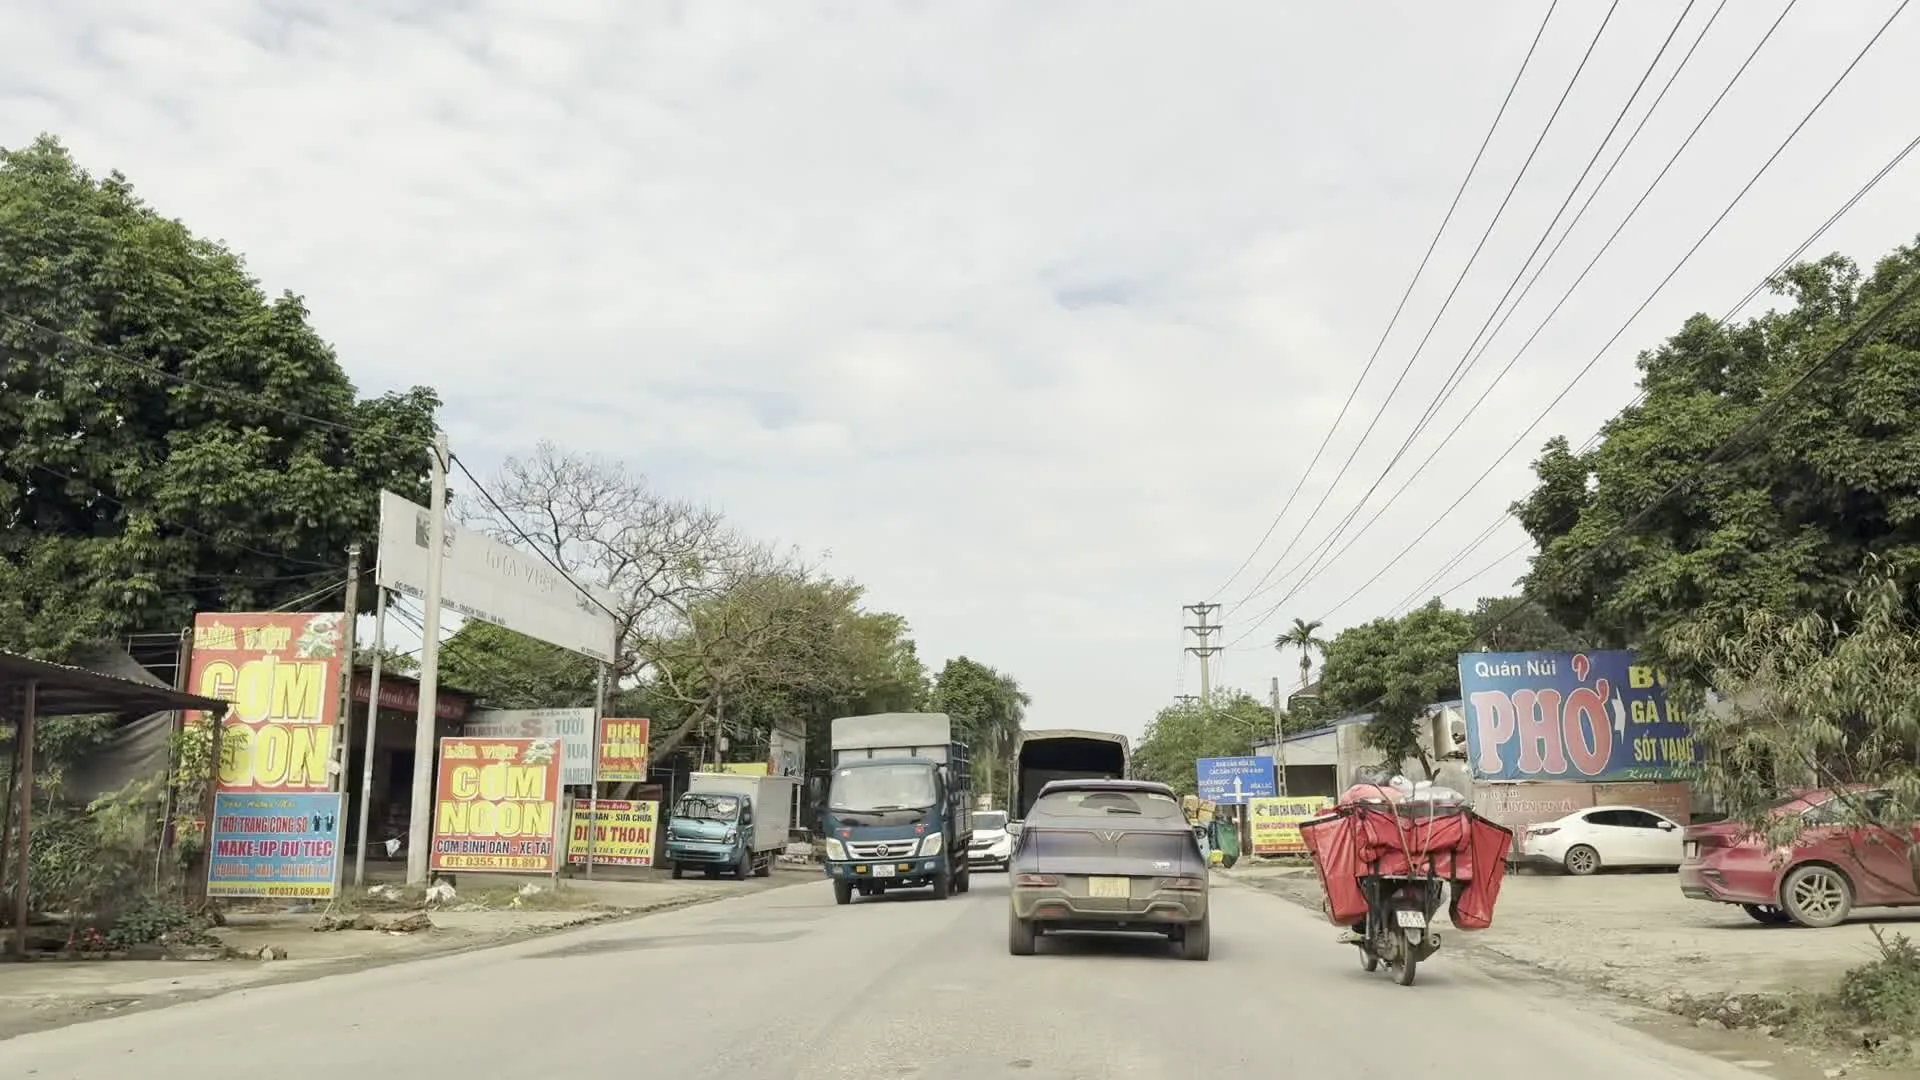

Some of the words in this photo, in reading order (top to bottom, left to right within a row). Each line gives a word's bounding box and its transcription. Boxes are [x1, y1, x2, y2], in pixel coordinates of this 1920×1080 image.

[1475, 661, 1521, 677] Quán
[1527, 660, 1556, 676] Núi
[200, 655, 329, 725] CƠM
[1471, 653, 1613, 776] PHỞ
[1631, 697, 1660, 724] GÀ
[1633, 729, 1657, 762] SỐT
[1659, 737, 1695, 763] VANG
[451, 762, 547, 801] CƠM
[239, 815, 268, 833] TRANG
[439, 800, 554, 838] NGON
[437, 839, 459, 854] CƠM
[462, 837, 486, 854] BÌNH
[488, 837, 510, 855] DÂN
[519, 841, 534, 855] XE
[574, 824, 607, 842] ĐIN
[610, 825, 651, 845] THOẠI
[216, 839, 278, 857] MAKE-UP
[303, 837, 333, 861] TIỆC
